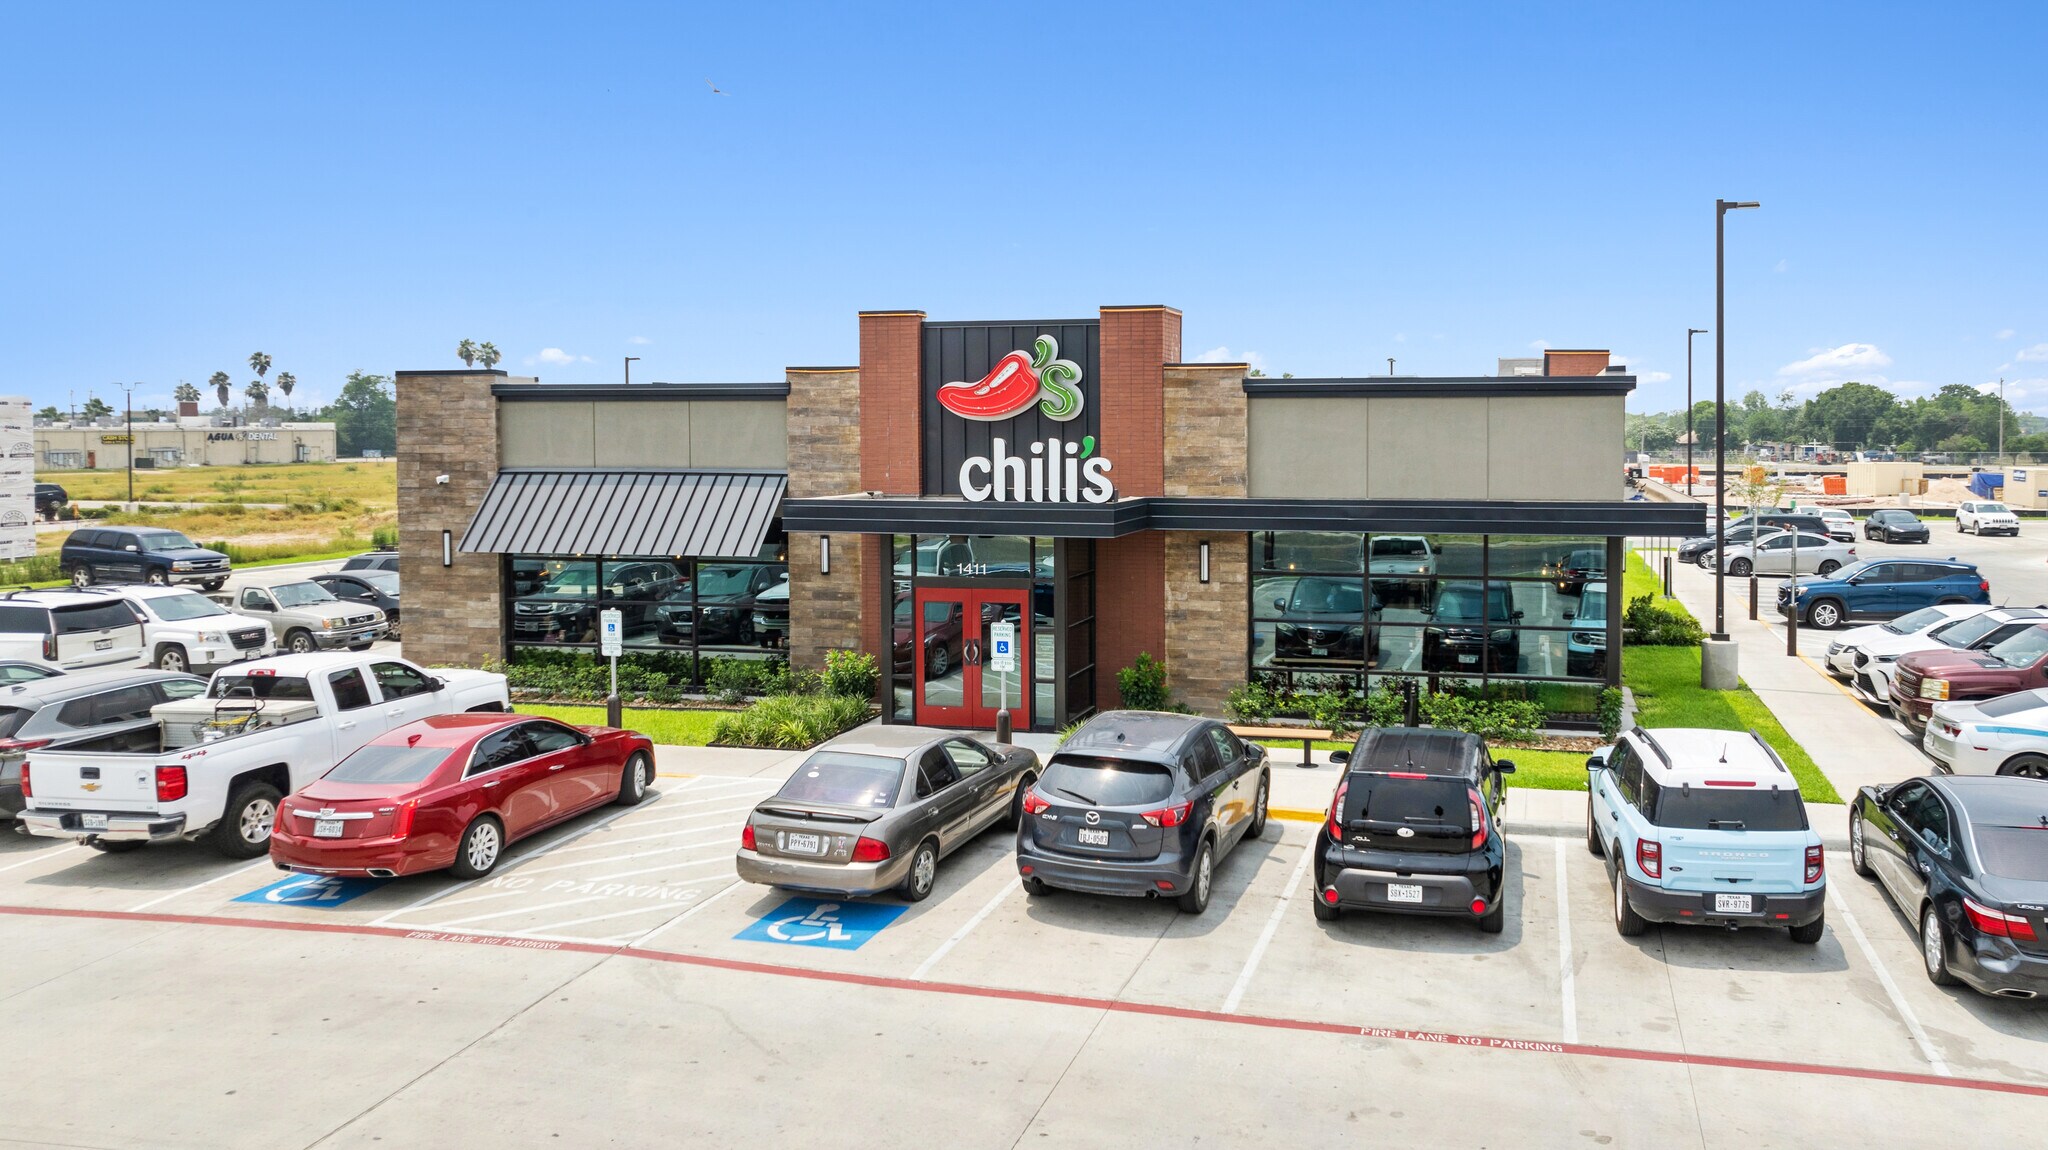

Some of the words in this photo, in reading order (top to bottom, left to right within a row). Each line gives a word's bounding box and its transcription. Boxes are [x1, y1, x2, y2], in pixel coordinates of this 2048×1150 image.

[207, 432, 234, 440] AGUA
[248, 432, 278, 440] DENTAL
[959, 435, 1114, 504] chili's
[956, 562, 987, 576] 1411
[480, 877, 534, 889] NO
[542, 880, 702, 901] PARKING
[2017, 903, 2044, 911] LEXUS
[406, 931, 440, 940] FIRE
[442, 934, 477, 943] LANE
[479, 937, 500, 945] NO
[502, 939, 562, 950] PARKING
[1361, 1027, 1398, 1038] FIRE
[1405, 1031, 1449, 1043] LANE
[1457, 1036, 1482, 1046] NO
[1490, 1038, 1563, 1052] PARKING
